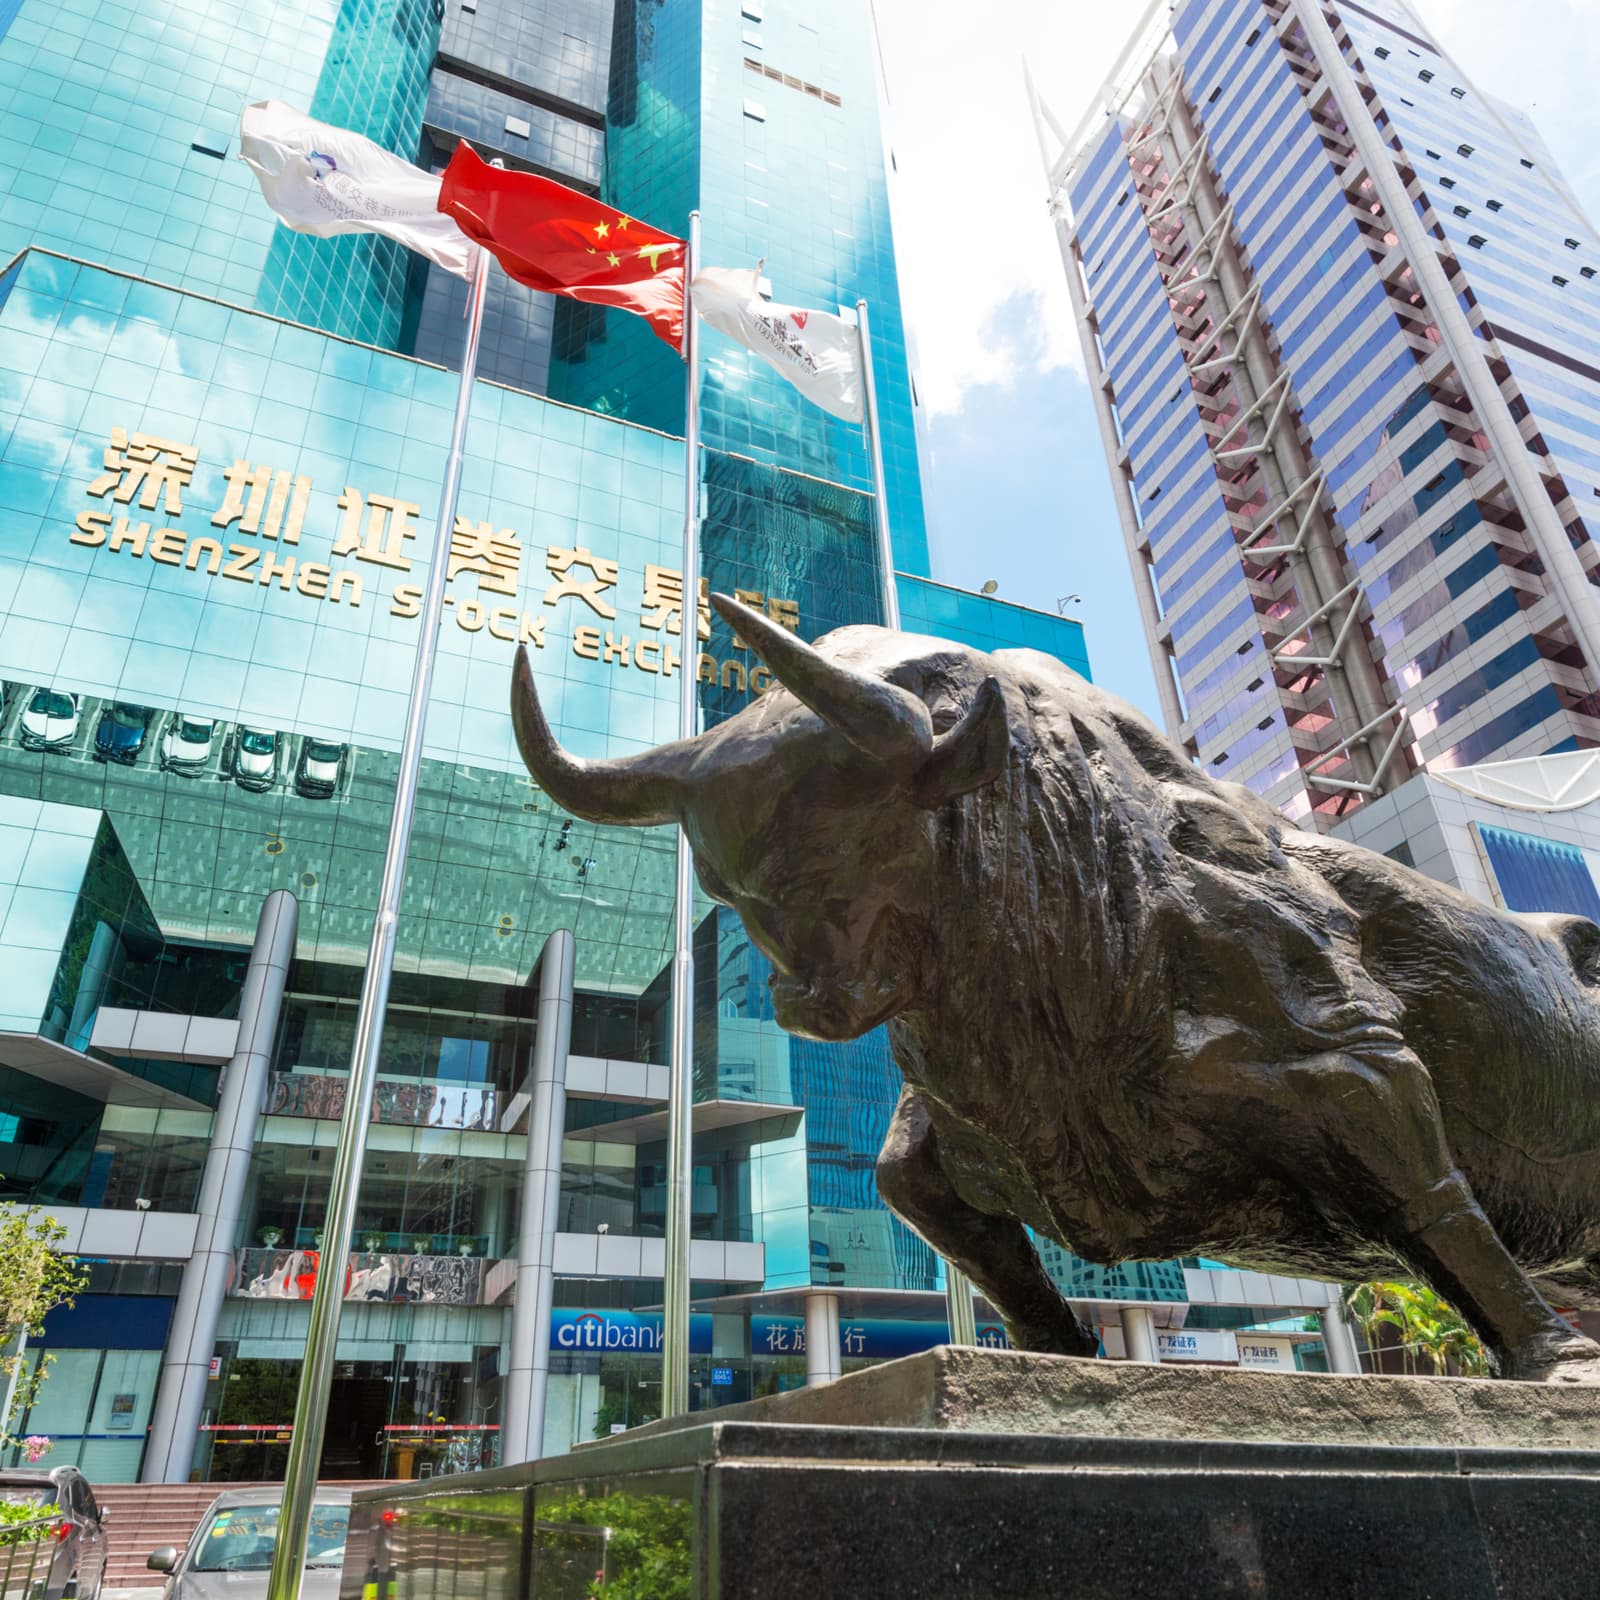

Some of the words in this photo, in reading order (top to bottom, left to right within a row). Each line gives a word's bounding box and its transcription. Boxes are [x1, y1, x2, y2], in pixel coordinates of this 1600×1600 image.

[69, 510, 364, 608] SHENZHEN
[572, 624, 772, 698] EXCHANG
[1158, 1335, 1197, 1348] 广发证券
[1243, 1345, 1278, 1358] 广发证券
